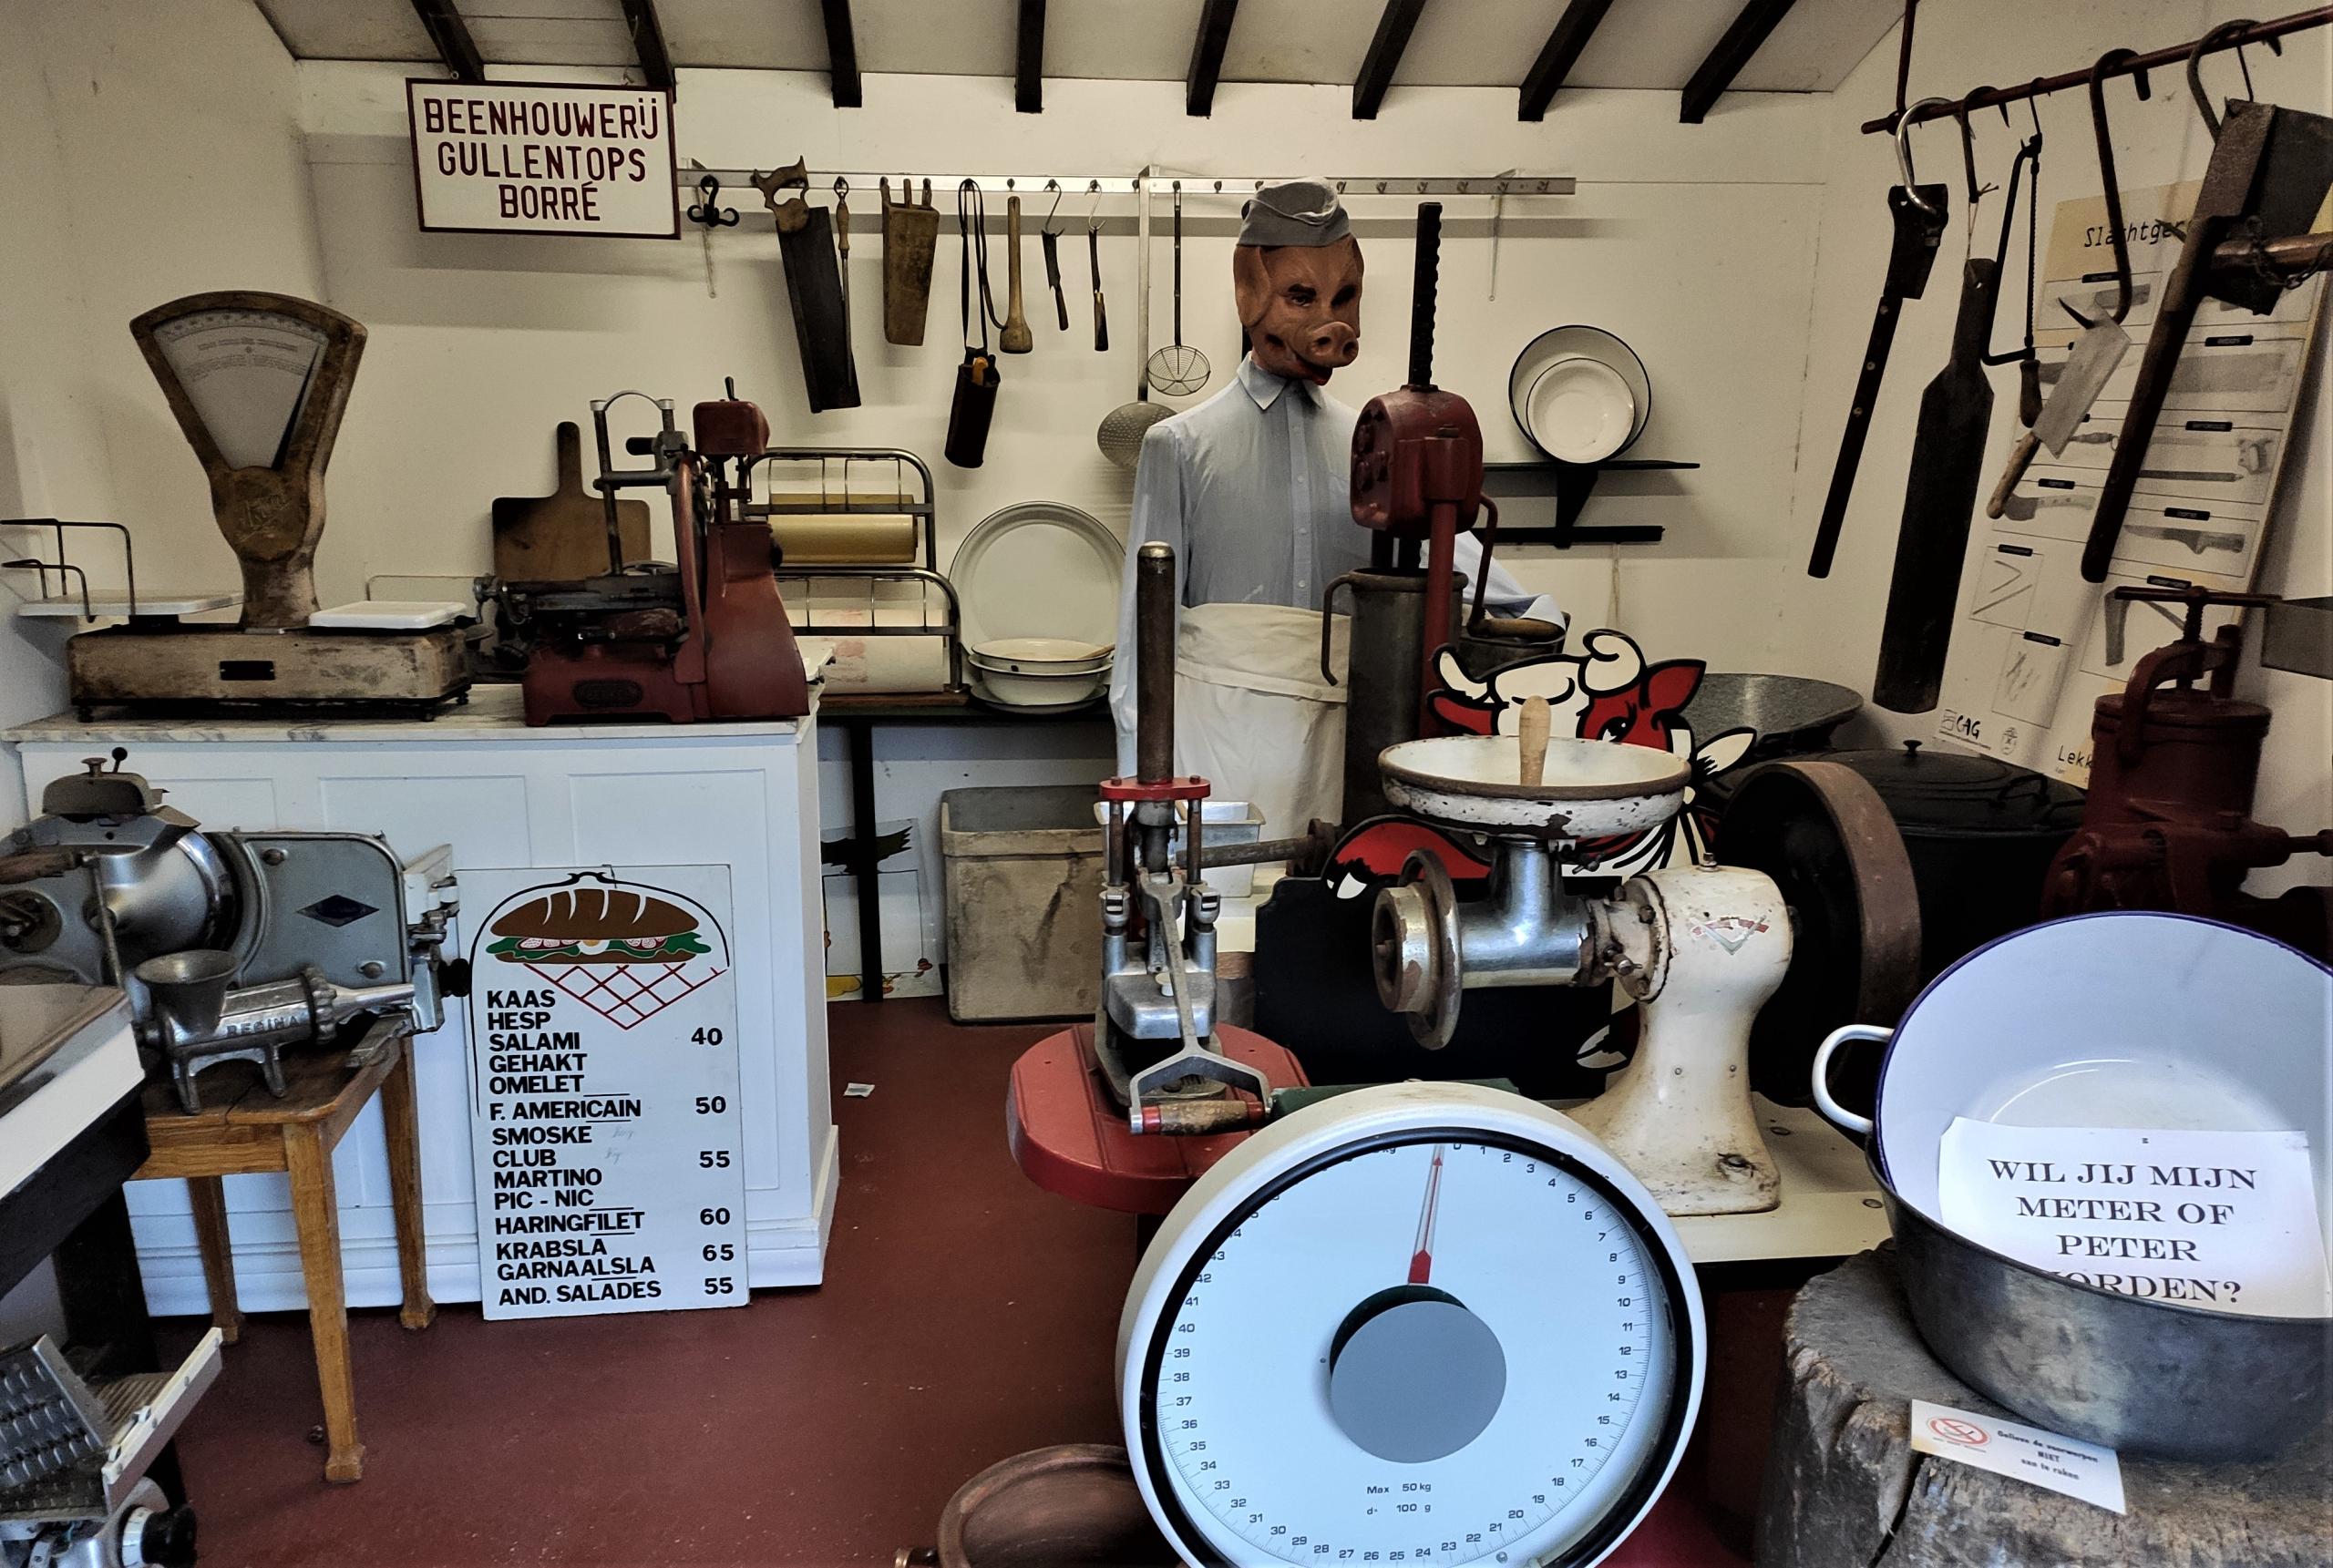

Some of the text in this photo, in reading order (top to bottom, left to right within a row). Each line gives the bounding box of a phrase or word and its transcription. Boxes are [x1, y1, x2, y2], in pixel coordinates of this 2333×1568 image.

[437, 141, 646, 182] GULLENTOPS
[498, 180, 601, 221] BORRÉ
[487, 989, 556, 1009] KAAS
[488, 1011, 551, 1030] HESP
[488, 1031, 581, 1052] SALAMI
[691, 1027, 724, 1046] 40
[488, 1053, 588, 1073] GEHAKT
[489, 1074, 585, 1095] OMELET
[489, 1099, 642, 1121] F. AMERICAIN
[695, 1096, 726, 1114] 50
[492, 1125, 592, 1146] SMOSKE
[1480, 1146, 1485, 1154] 1
[493, 1149, 557, 1168] CLUB
[699, 1150, 731, 1169] 55
[1503, 1153, 1511, 1163] 2
[1526, 1163, 1535, 1173] 3
[494, 1167, 602, 1189] MARTINO
[1987, 1159, 2257, 1190] WIL JIJ MIJN
[1547, 1178, 1557, 1188] 4
[494, 1191, 533, 1210] PIC
[555, 1188, 594, 1207] NIC
[1567, 1194, 1576, 1203] 5
[2016, 1196, 2235, 1225] METER OF
[700, 1208, 731, 1225] 60
[1584, 1211, 1593, 1221] 6
[495, 1211, 645, 1235] HARINGFILET
[1598, 1233, 1606, 1242] 7
[496, 1238, 608, 1260] KRABSLA
[703, 1244, 735, 1261] 65
[2056, 1235, 2201, 1262] PETER
[1609, 1253, 1618, 1263] 8
[497, 1255, 655, 1281] GARNAALSLA
[1618, 1275, 1626, 1285] 9
[704, 1277, 734, 1296] 55
[498, 1280, 662, 1306] AND. SALADES
[1185, 1296, 1198, 1306] 41
[1617, 1297, 1630, 1307] 10
[1177, 1323, 1196, 1333] 40
[1622, 1323, 1633, 1332] 11
[1174, 1348, 1190, 1358] 39
[1619, 1347, 1631, 1356] 12
[1174, 1372, 1190, 1381] 38
[1615, 1370, 1628, 1379] 13
[1176, 1397, 1192, 1407] 37
[1608, 1393, 1620, 1401] 14
[1181, 1419, 1197, 1430] 36
[1597, 1416, 1609, 1425] 15
[1190, 1441, 1206, 1450] 35
[1584, 1438, 1597, 1447] 16
[1201, 1461, 1217, 1471] 34
[1571, 1458, 1584, 1468] 17
[1214, 1480, 1230, 1490] 33
[1552, 1478, 1565, 1487] 18
[1367, 1482, 1432, 1494] Max 50 kg
[1230, 1498, 1247, 1508] 32
[1532, 1494, 1545, 1503] 19
[1396, 1503, 1417, 1512] 100
[1424, 1504, 1431, 1512] g
[1249, 1514, 1263, 1523] 31
[1508, 1510, 1524, 1519] 20
[1270, 1525, 1286, 1535] 30
[1489, 1523, 1502, 1532] 21
[1291, 1536, 1307, 1545] 29
[1465, 1534, 1481, 1543] 22
[1314, 1544, 1329, 1553] 28
[1441, 1542, 1456, 1551] 23
[1339, 1550, 1354, 1559] 27
[1363, 1551, 1380, 1561] 26
[1389, 1551, 1405, 1560] 25
[1415, 1548, 1431, 1558] 24
